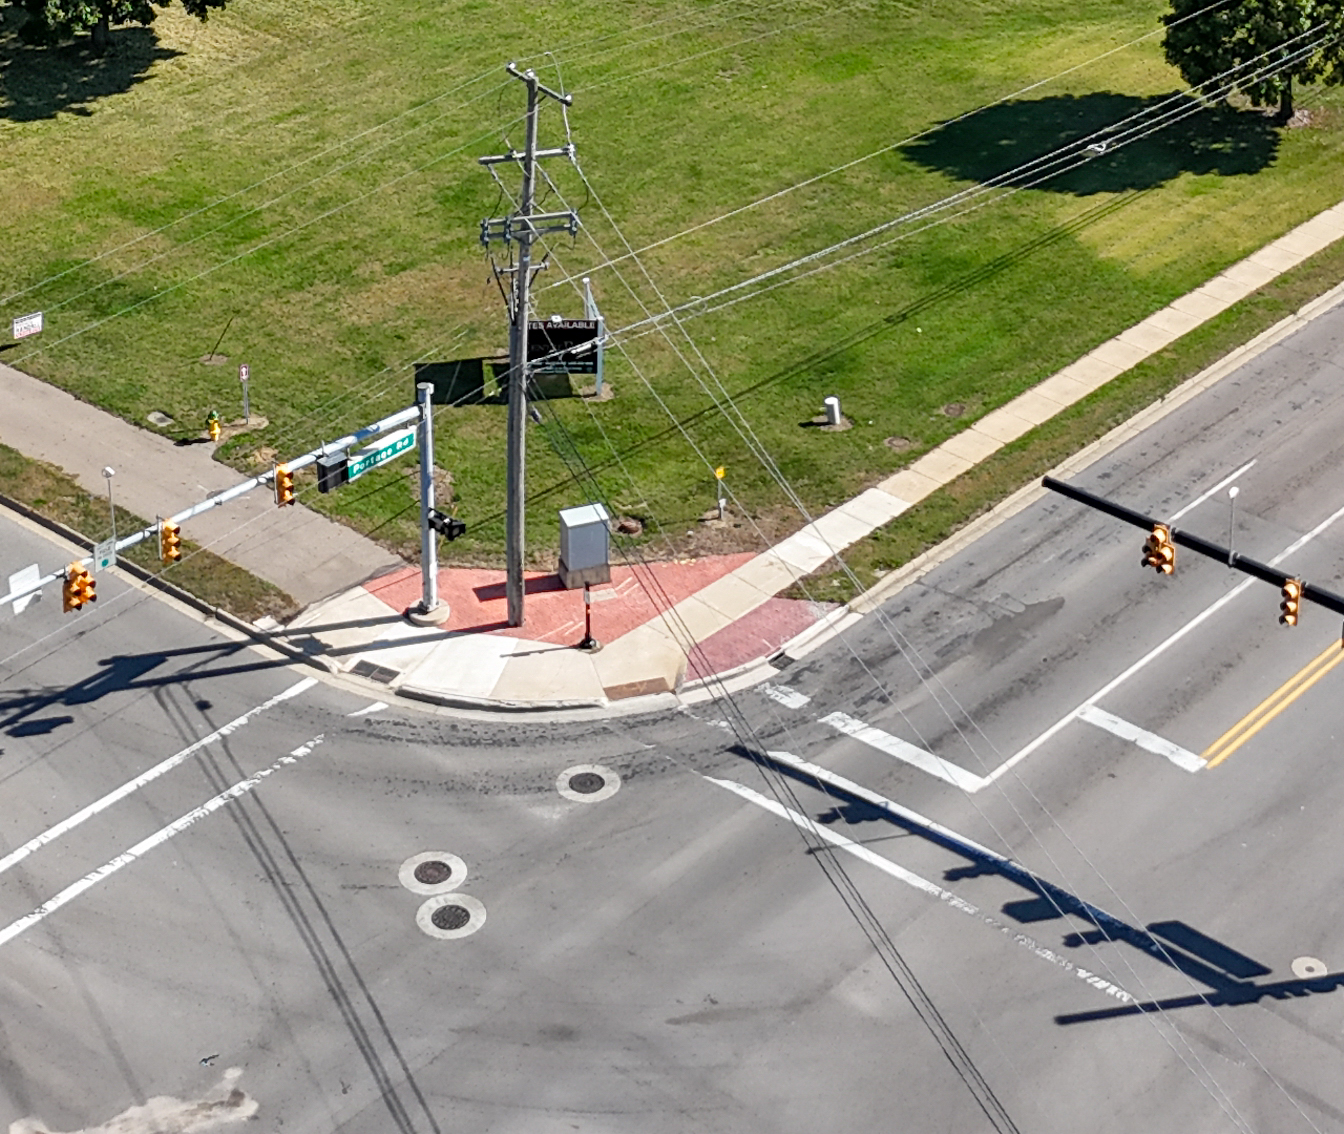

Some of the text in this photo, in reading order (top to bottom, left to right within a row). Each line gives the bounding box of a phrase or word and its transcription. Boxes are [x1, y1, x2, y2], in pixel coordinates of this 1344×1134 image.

[546, 321, 595, 330] AVAILABLE
[352, 437, 409, 474] Portage Rd
